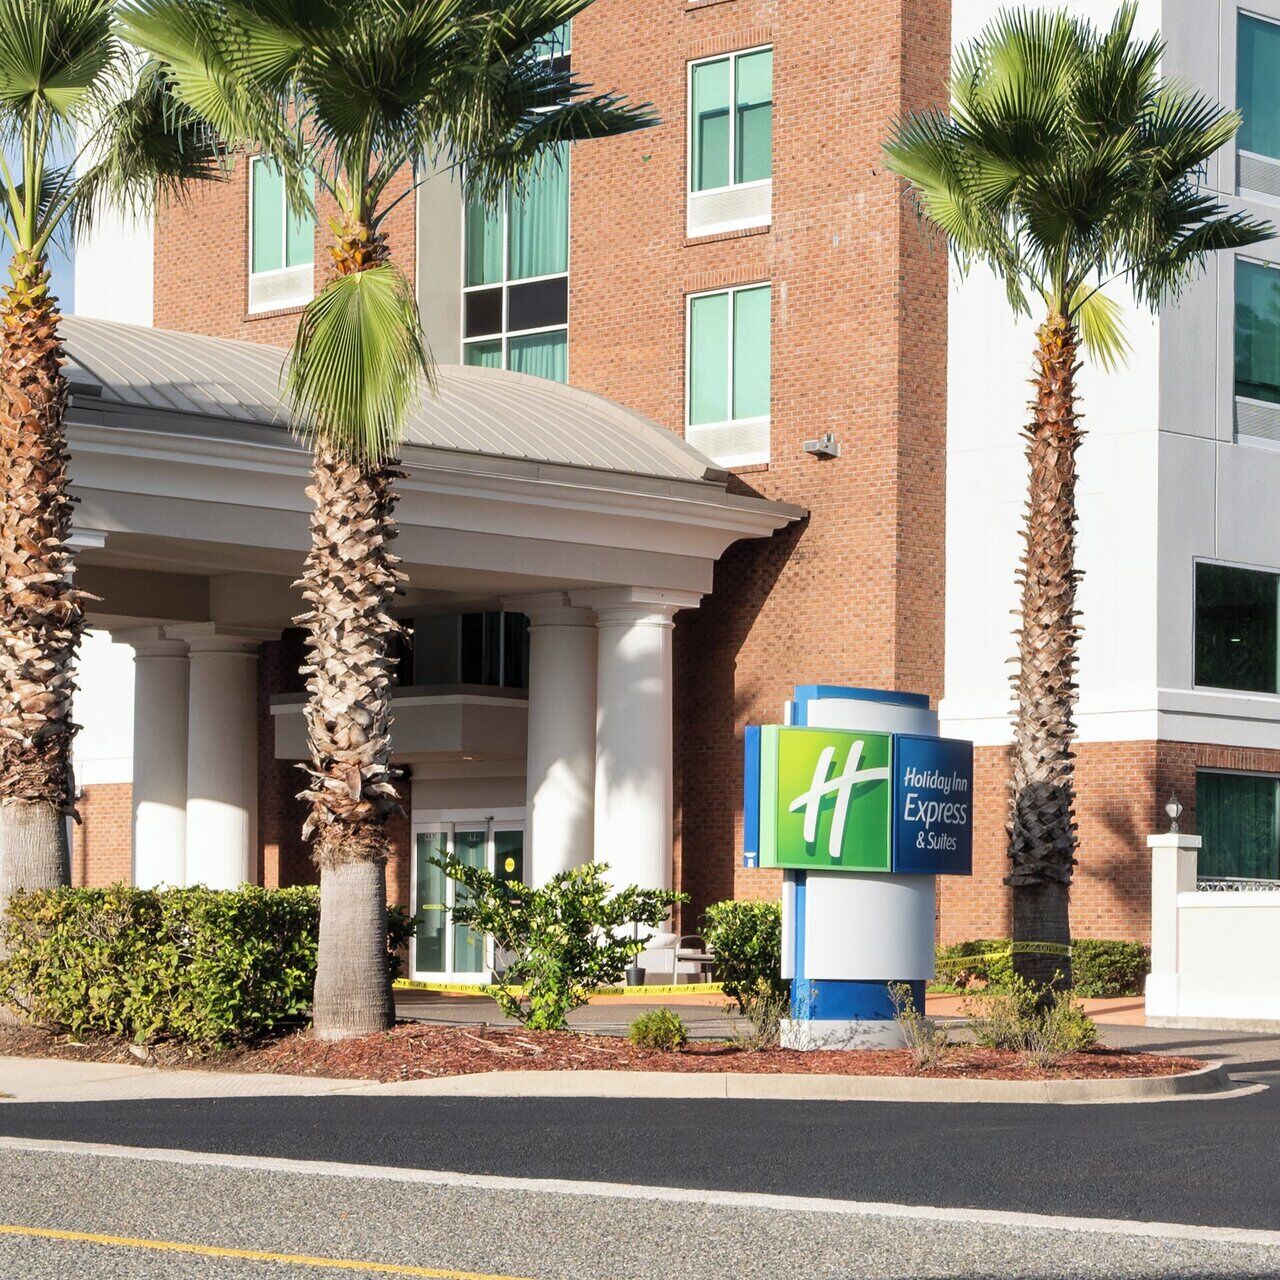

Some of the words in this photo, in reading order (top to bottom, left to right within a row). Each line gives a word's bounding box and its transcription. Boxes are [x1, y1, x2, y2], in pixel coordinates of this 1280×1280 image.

[904, 766, 951, 795] Holiday
[952, 771, 968, 792] Inn
[904, 792, 967, 829] Express
[916, 831, 925, 849] &
[927, 832, 957, 850] Suites
